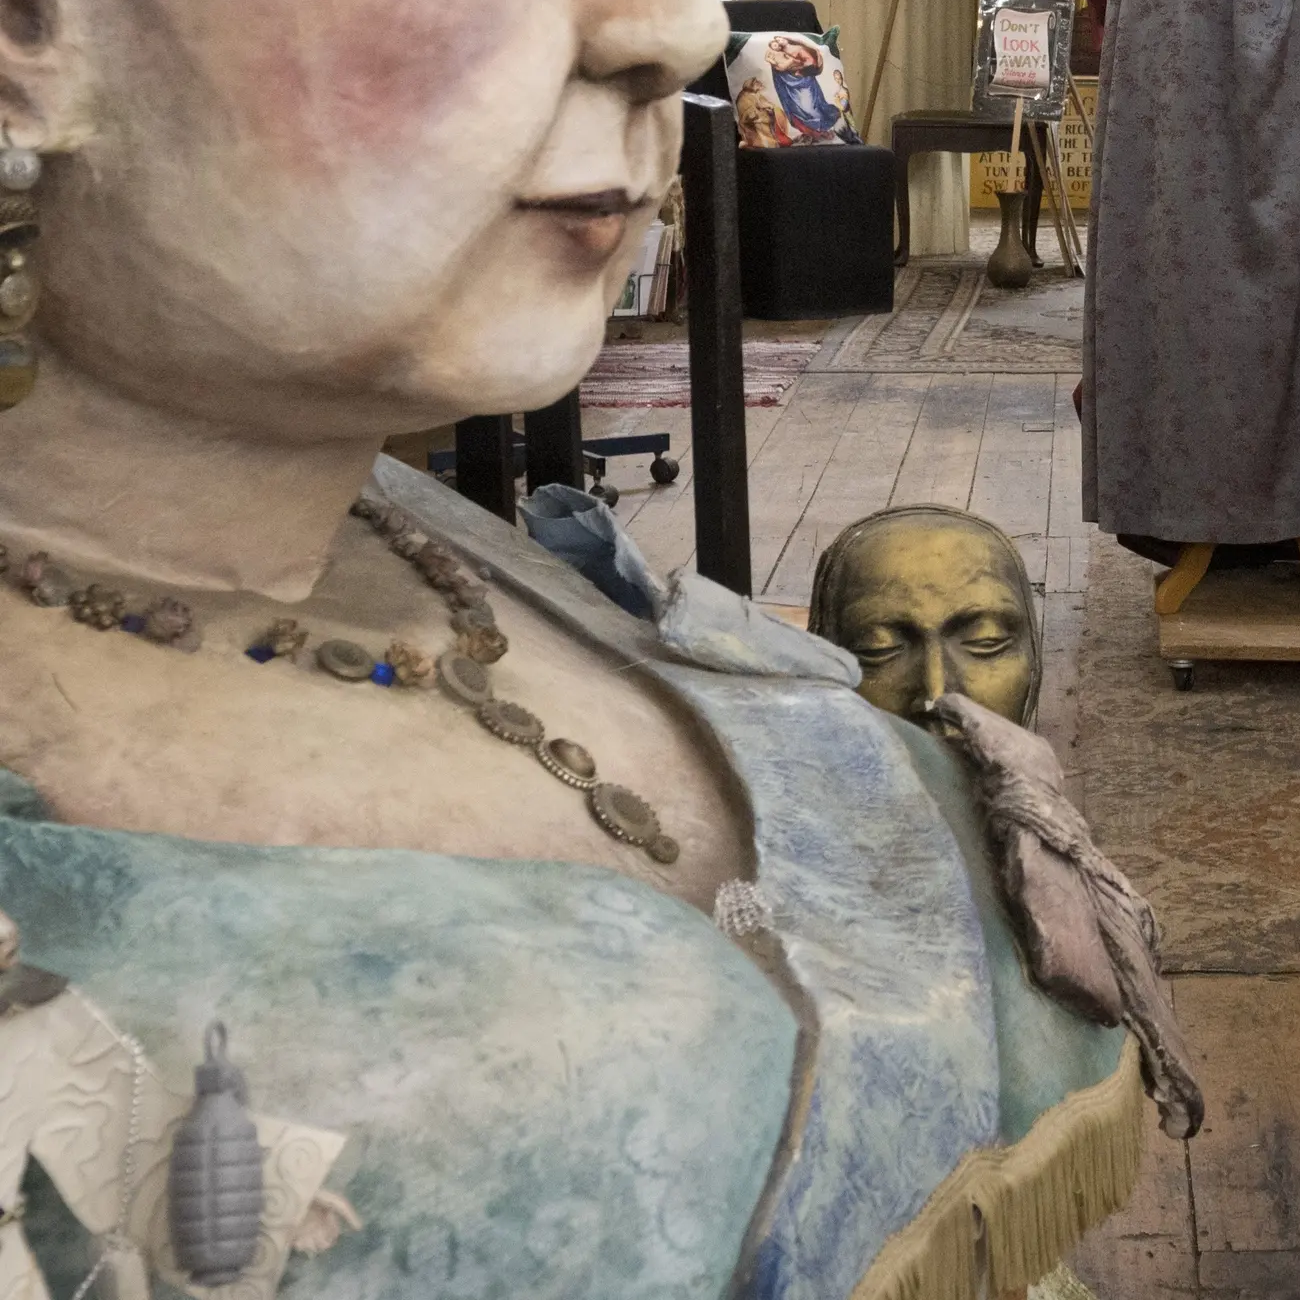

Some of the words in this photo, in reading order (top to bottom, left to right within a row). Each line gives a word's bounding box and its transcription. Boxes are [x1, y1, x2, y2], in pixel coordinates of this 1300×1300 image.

[1003, 36, 1040, 52] LOOK
[999, 54, 1047, 68] AWAY!
[979, 152, 992, 163] AT
[1067, 167, 1092, 177] BEE
[1071, 180, 1090, 191] OF
